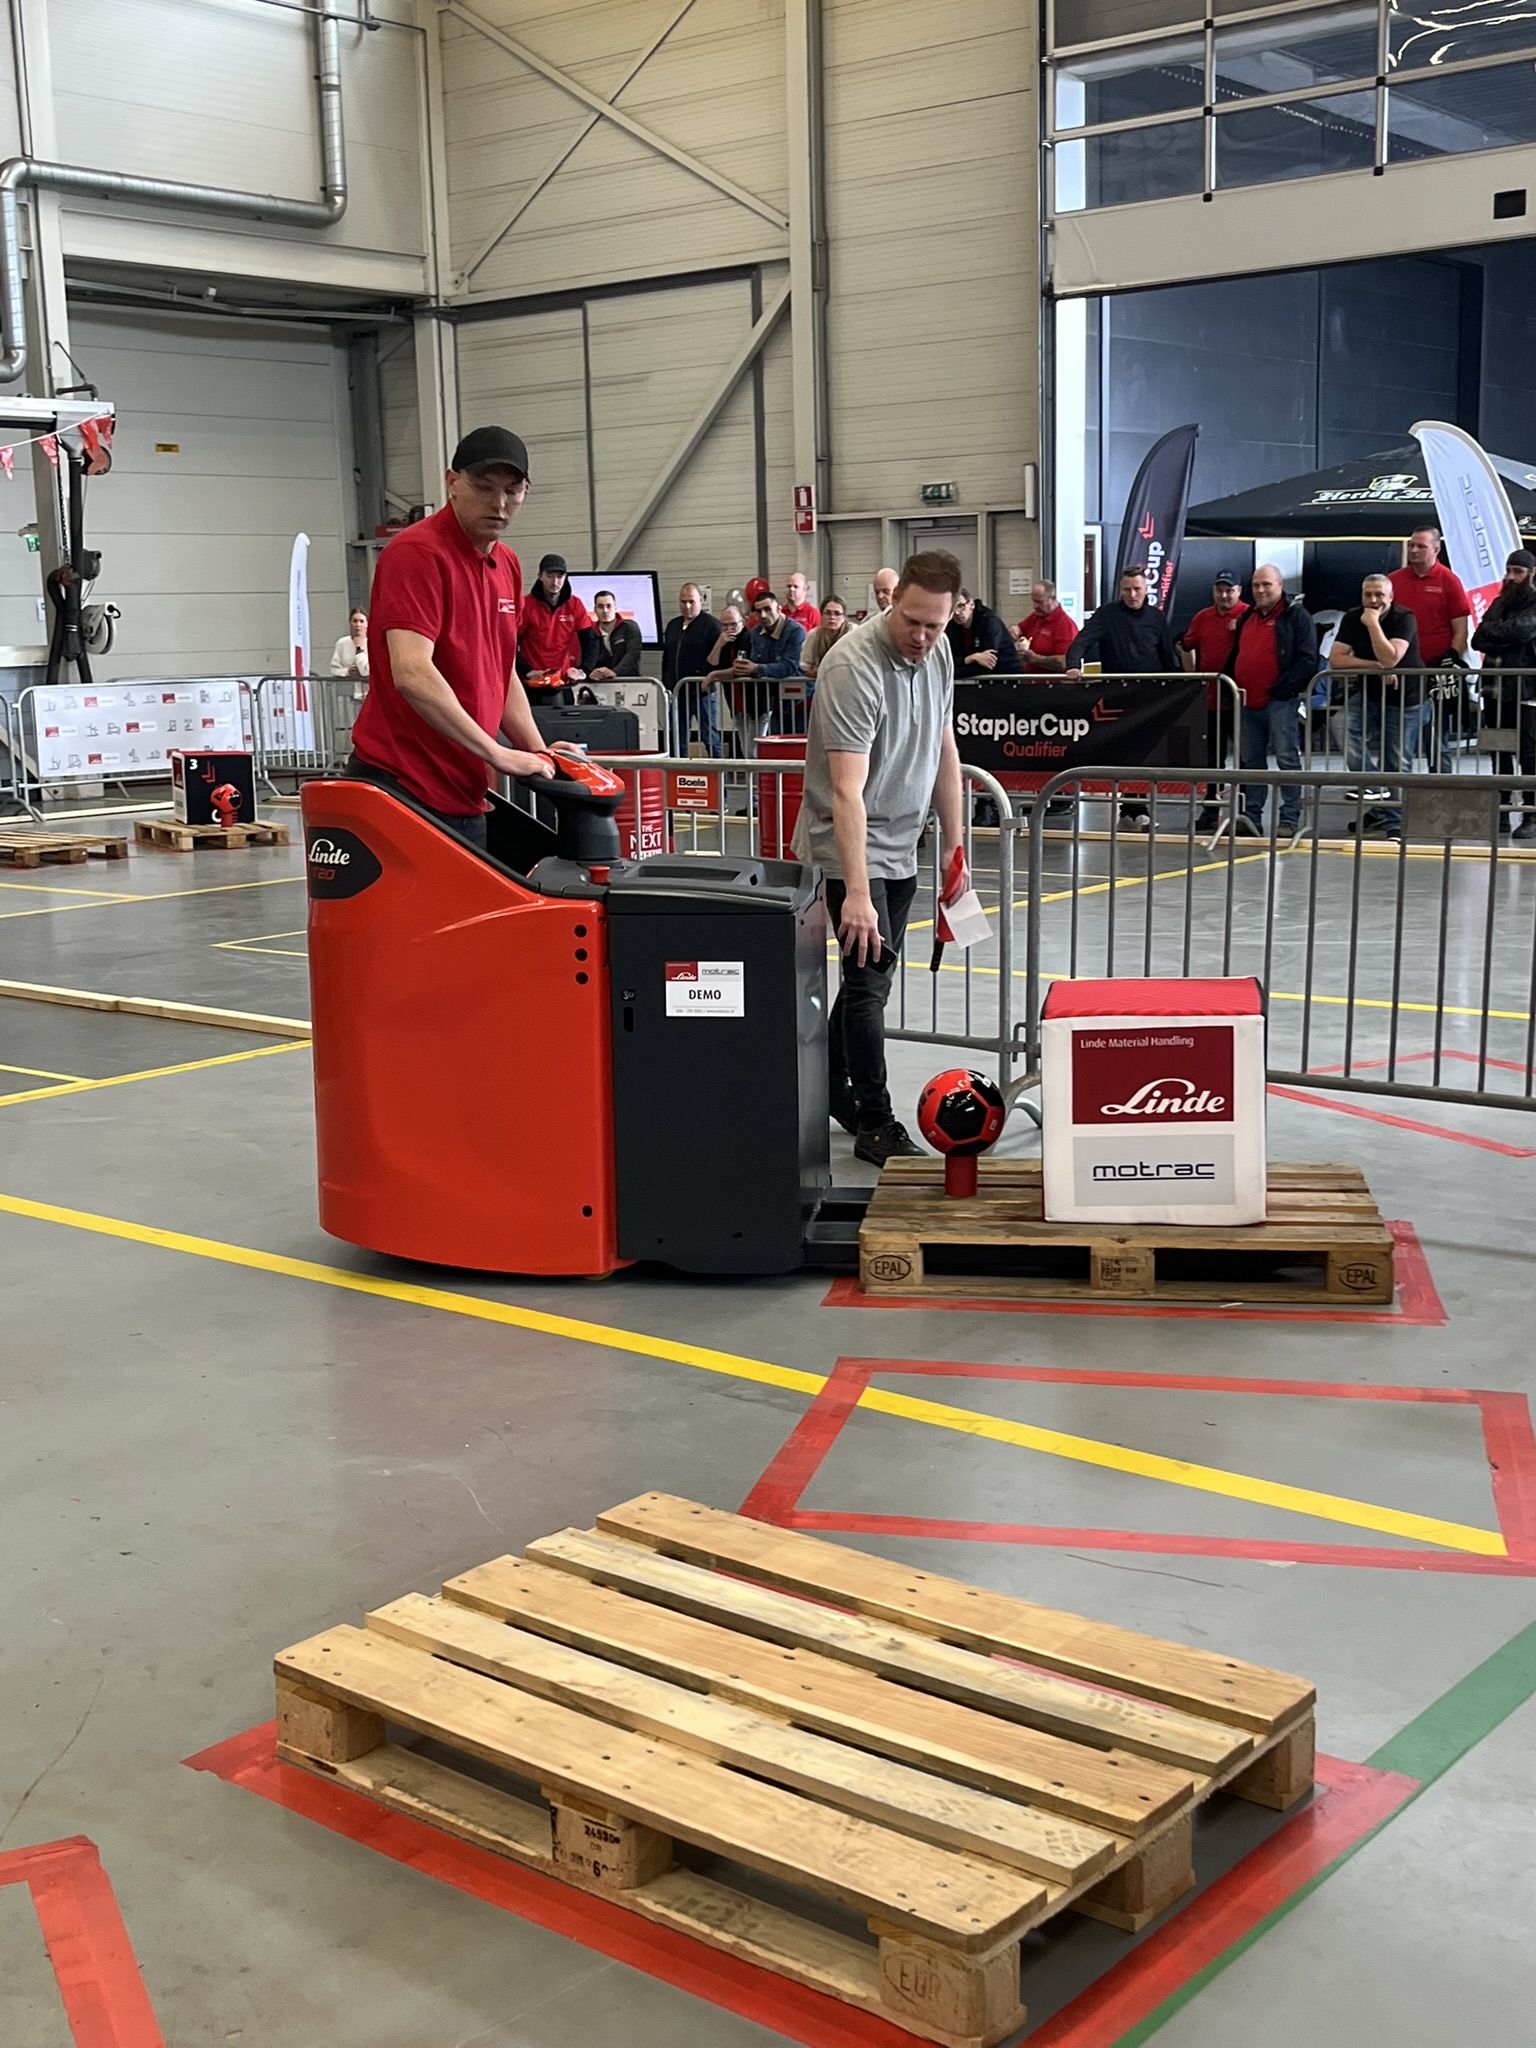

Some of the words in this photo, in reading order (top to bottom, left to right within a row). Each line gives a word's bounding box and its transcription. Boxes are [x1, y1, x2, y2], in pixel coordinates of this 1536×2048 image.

[1312, 489, 1395, 503] Hertog
[1144, 541, 1165, 607] erCup
[957, 713, 1090, 742] StaplerCup
[1002, 741, 1068, 757] Qualifier
[189, 758, 198, 770] 3
[678, 778, 706, 787] Boels
[641, 824, 653, 832] THE
[307, 838, 351, 865] Linde
[688, 989, 722, 1000] DEMO
[1080, 1038, 1107, 1049] Linde
[1108, 1036, 1150, 1048] Material
[1150, 1035, 1195, 1048] Handling
[1100, 1077, 1226, 1115] Linde
[1093, 1161, 1216, 1178] motrac
[874, 1260, 905, 1276] EPAL
[1346, 1268, 1378, 1285] EPAL
